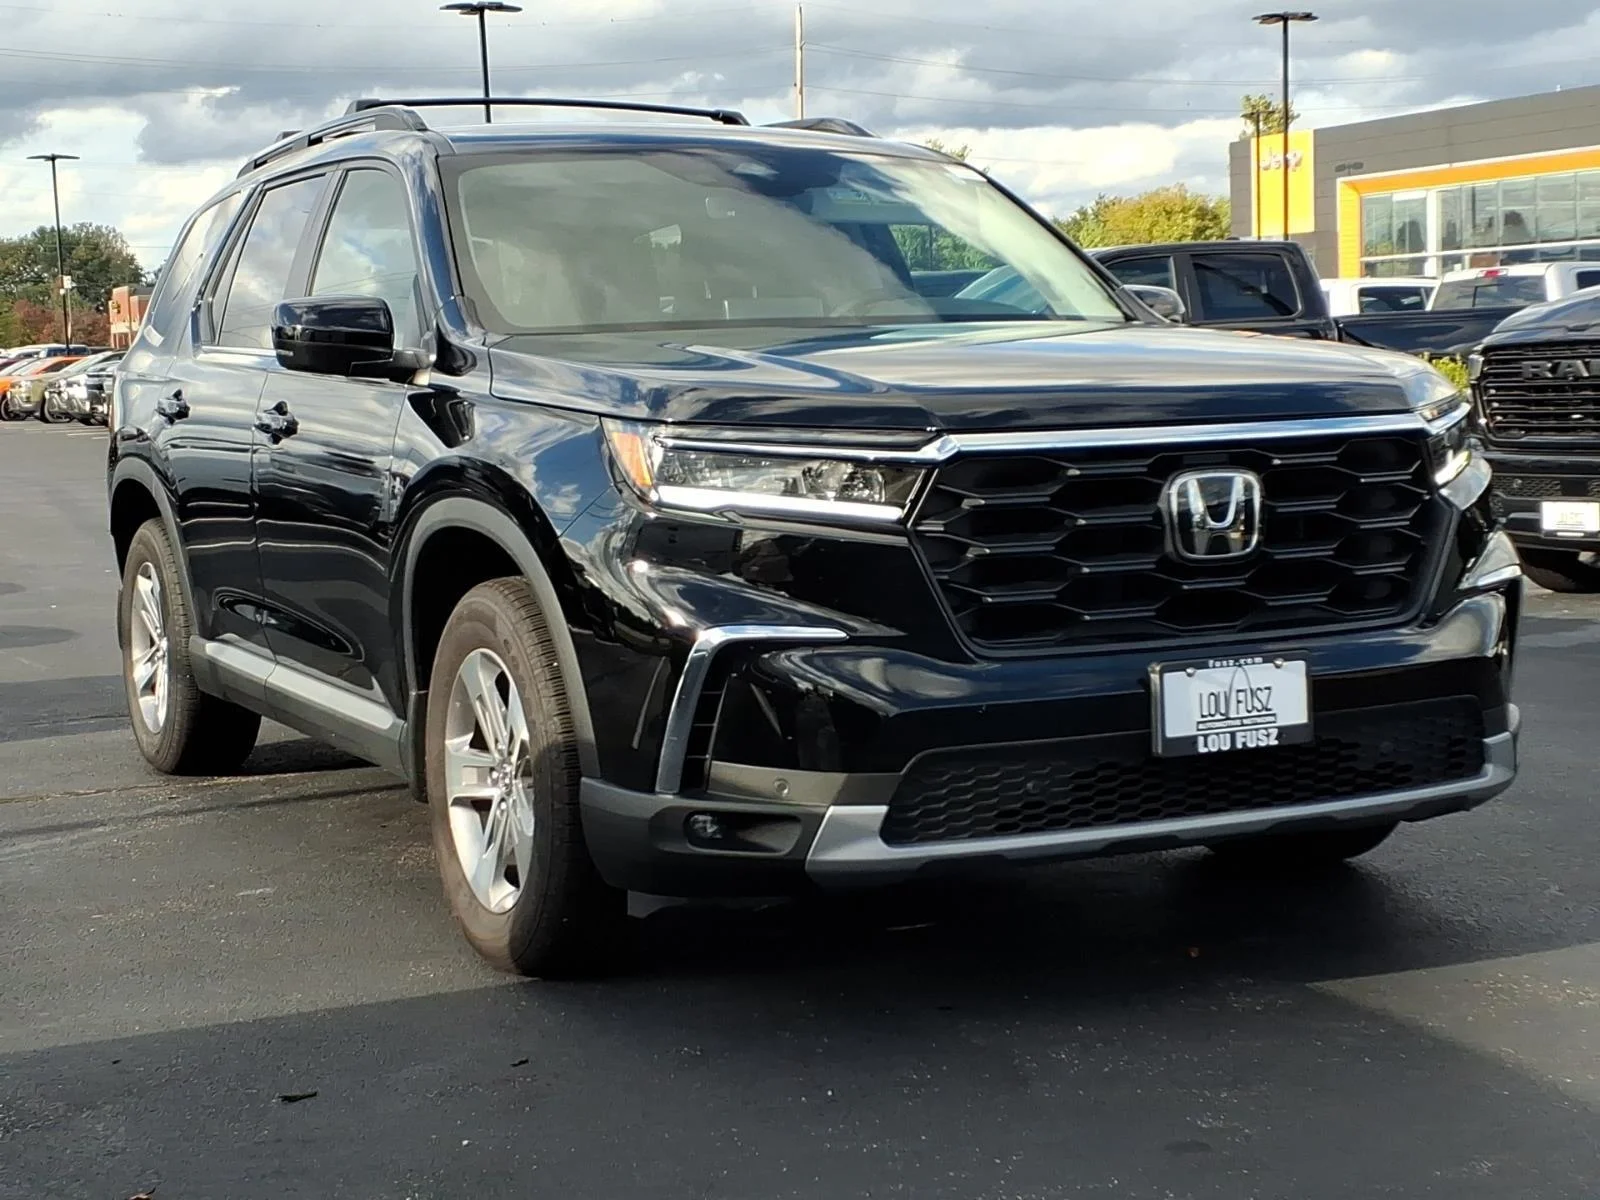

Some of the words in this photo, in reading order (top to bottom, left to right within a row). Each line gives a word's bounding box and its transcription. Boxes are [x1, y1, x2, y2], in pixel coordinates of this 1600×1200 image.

[1200, 691, 1228, 718] LOU
[1236, 686, 1273, 715] FUSZ
[1197, 733, 1231, 754] LOU
[1236, 728, 1279, 749] FUSZ
